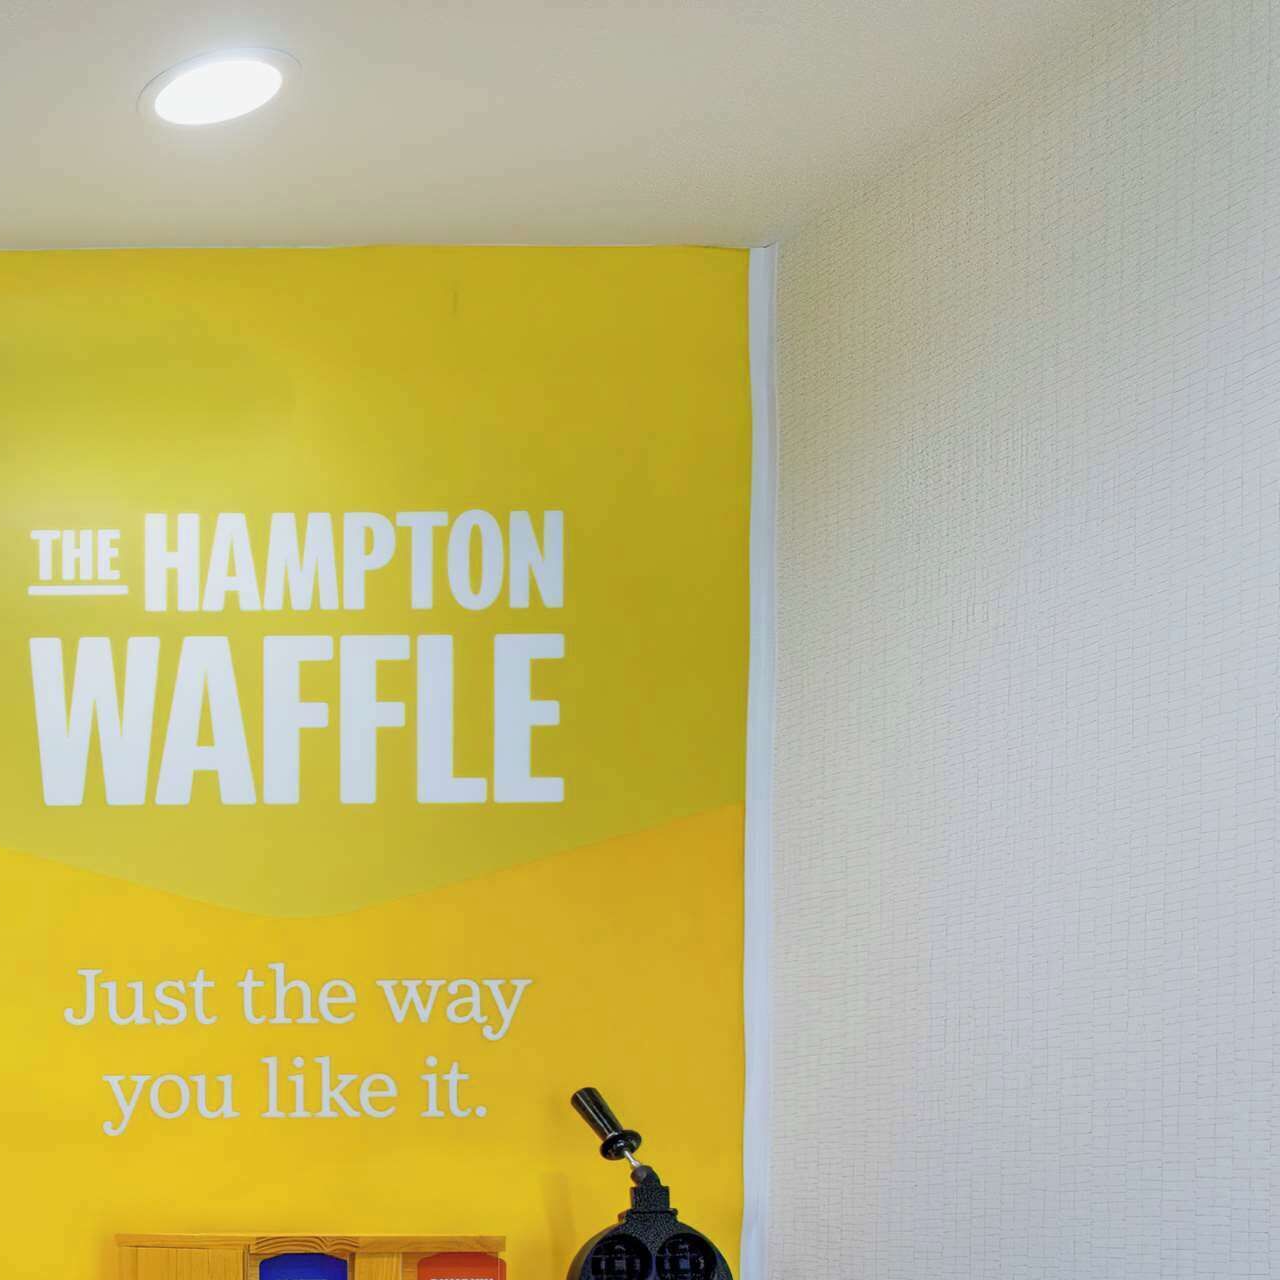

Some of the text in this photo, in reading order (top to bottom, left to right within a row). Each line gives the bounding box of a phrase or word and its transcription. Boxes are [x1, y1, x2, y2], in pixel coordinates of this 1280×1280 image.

[30, 508, 565, 613] THE HAMPTON
[28, 633, 566, 807] WAFFLE
[63, 962, 534, 1042] Just the way
[101, 1055, 489, 1138] you like it.
